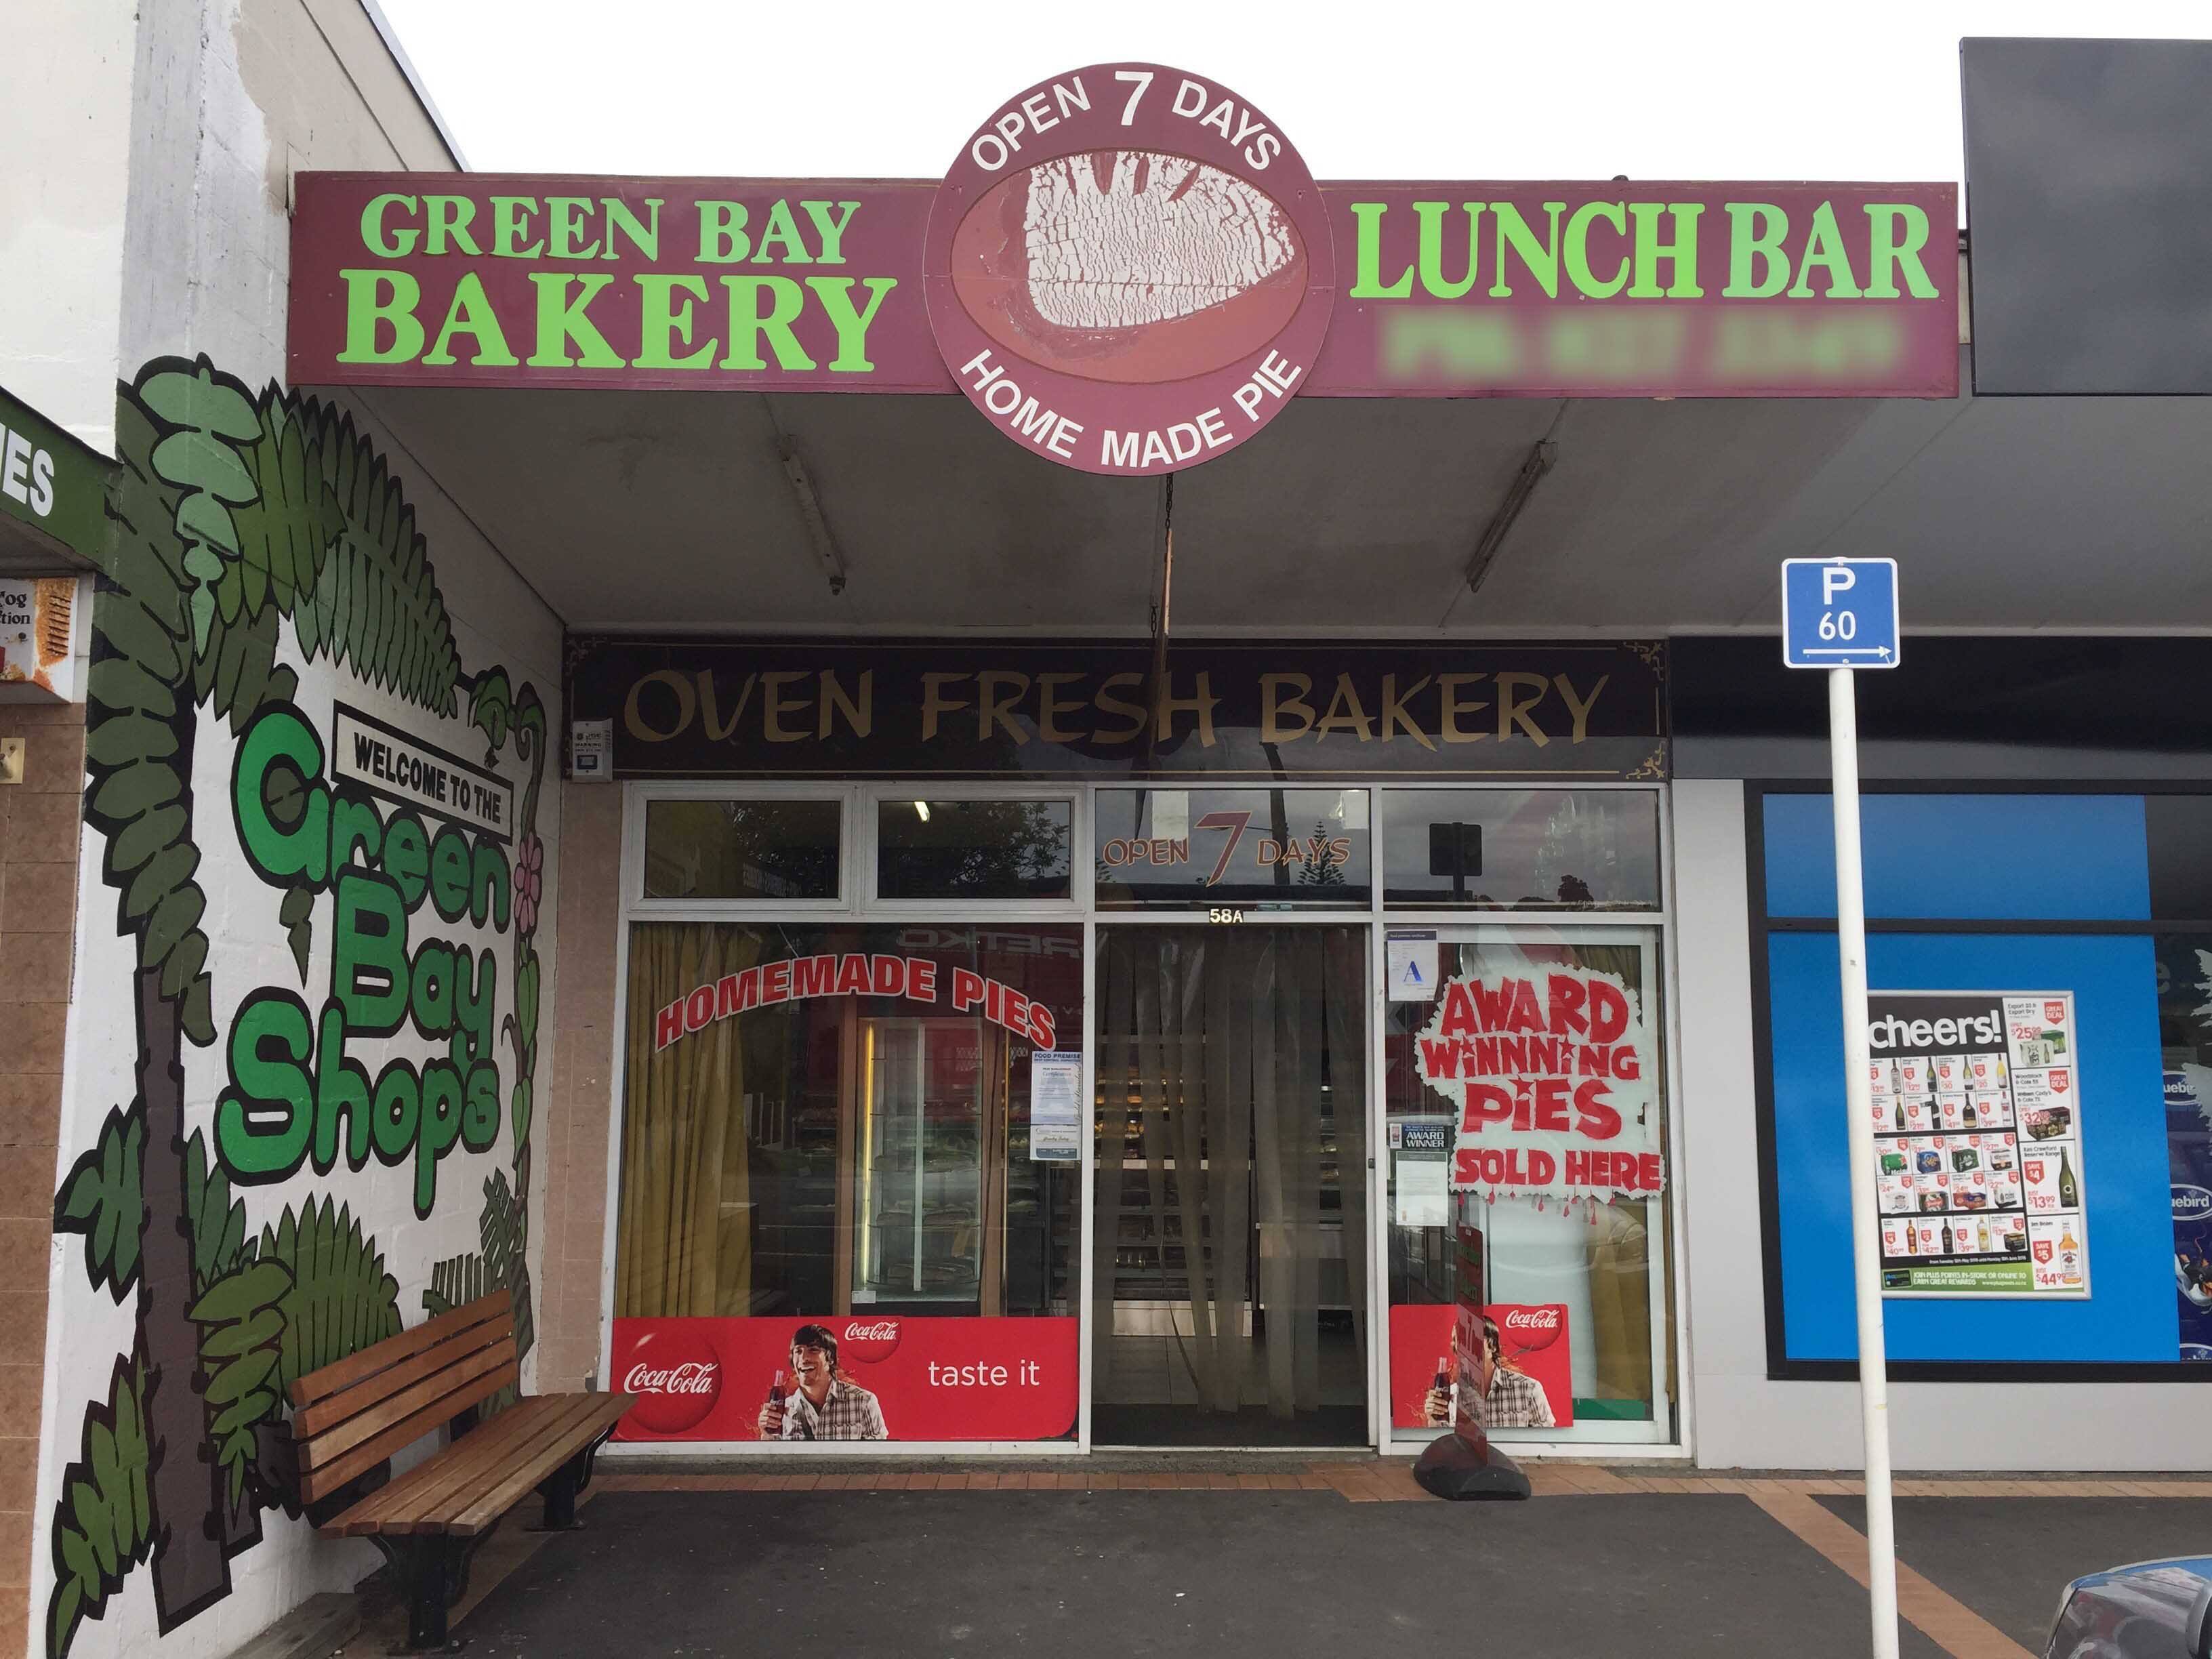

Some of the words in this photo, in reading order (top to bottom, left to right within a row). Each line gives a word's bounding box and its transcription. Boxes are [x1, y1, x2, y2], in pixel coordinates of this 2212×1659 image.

[972, 76, 1091, 171] OPEN
[1115, 70, 1153, 125] 7
[1172, 79, 1281, 169] DAYS
[360, 194, 664, 262] GREEN
[693, 199, 861, 264] BAY
[1349, 201, 1706, 300] LUNCH
[1722, 200, 1940, 299] BAR
[335, 269, 897, 371] BAKERY
[960, 349, 1083, 458] HOME
[1101, 407, 1233, 468] MADE
[1232, 349, 1302, 422] PIE
[0, 611, 30, 624] tion
[1823, 567, 1856, 605] P
[1818, 611, 1856, 640] 60
[625, 668, 873, 743] OVEN
[920, 668, 1221, 747] FRESH
[1258, 671, 1610, 752] BAKERY
[354, 732, 447, 802] WELCOME
[450, 774, 470, 811] TO
[474, 784, 501, 824] THE
[234, 702, 510, 932] Green
[1103, 838, 1188, 867] OPEN
[1194, 811, 1252, 888] 7
[1256, 837, 1350, 866] DAYS
[1209, 908, 1244, 924] 58A
[333, 867, 495, 1072] Bay
[655, 954, 937, 1052] HOMEMADE
[952, 966, 1056, 1051] PIES
[1404, 960, 1422, 982] A
[1440, 972, 1629, 1044] AWARD
[1868, 1010, 2002, 1048] cheers!
[215, 987, 499, 1220] Shops
[1454, 1147, 1556, 1185] SOLD
[1565, 1149, 1662, 1191] HERE
[844, 1322, 899, 1342] Coca-Cola
[1505, 1309, 1559, 1328] Coca-Cola
[623, 1363, 718, 1395] Coca-Cola
[928, 1359, 1008, 1387] taste
[1021, 1359, 1040, 1386] it
